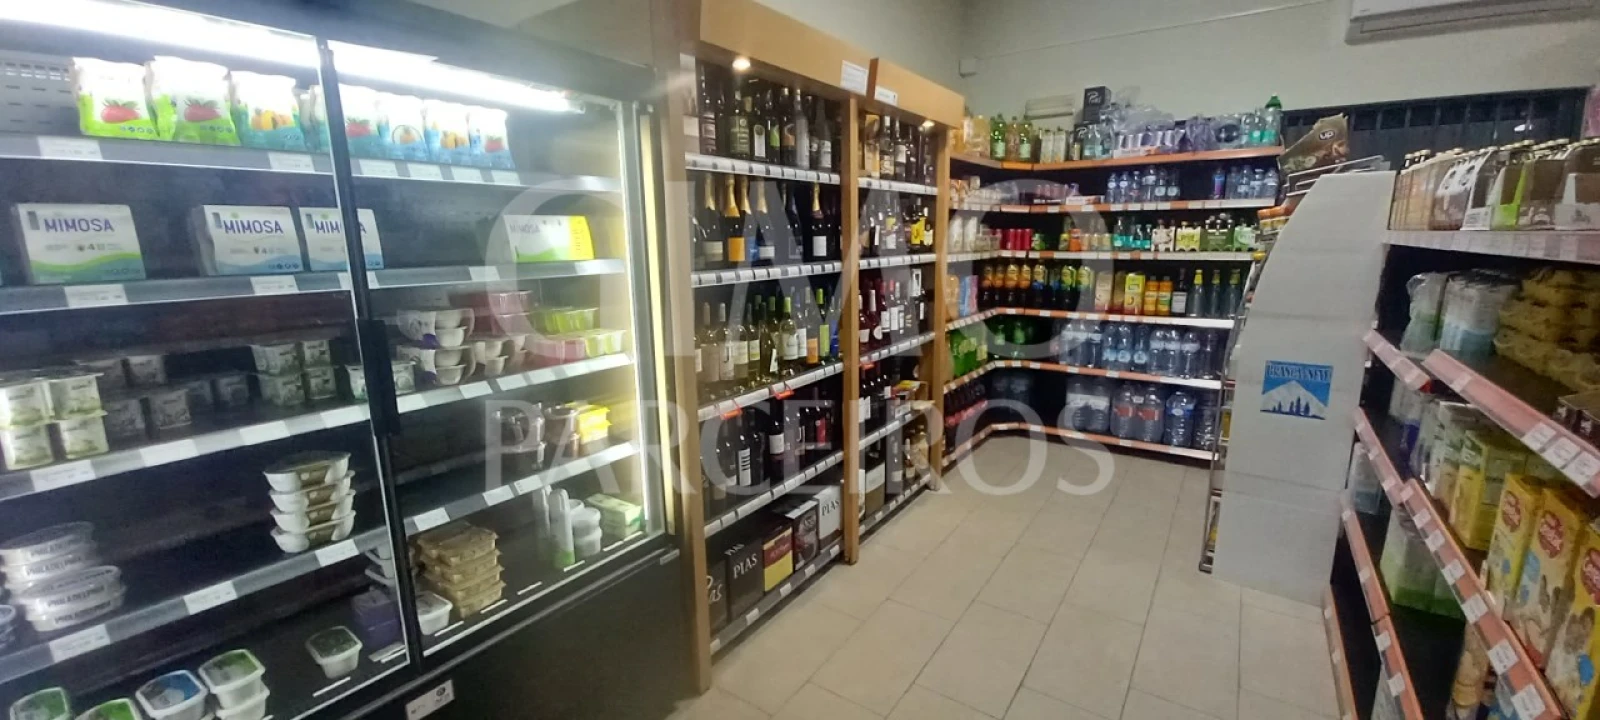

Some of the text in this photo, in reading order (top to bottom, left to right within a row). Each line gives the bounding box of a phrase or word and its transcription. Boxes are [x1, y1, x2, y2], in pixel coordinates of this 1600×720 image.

[43, 218, 115, 233] MIMOSA
[223, 219, 284, 235] MIMOSA
[733, 553, 757, 579] PIAS
